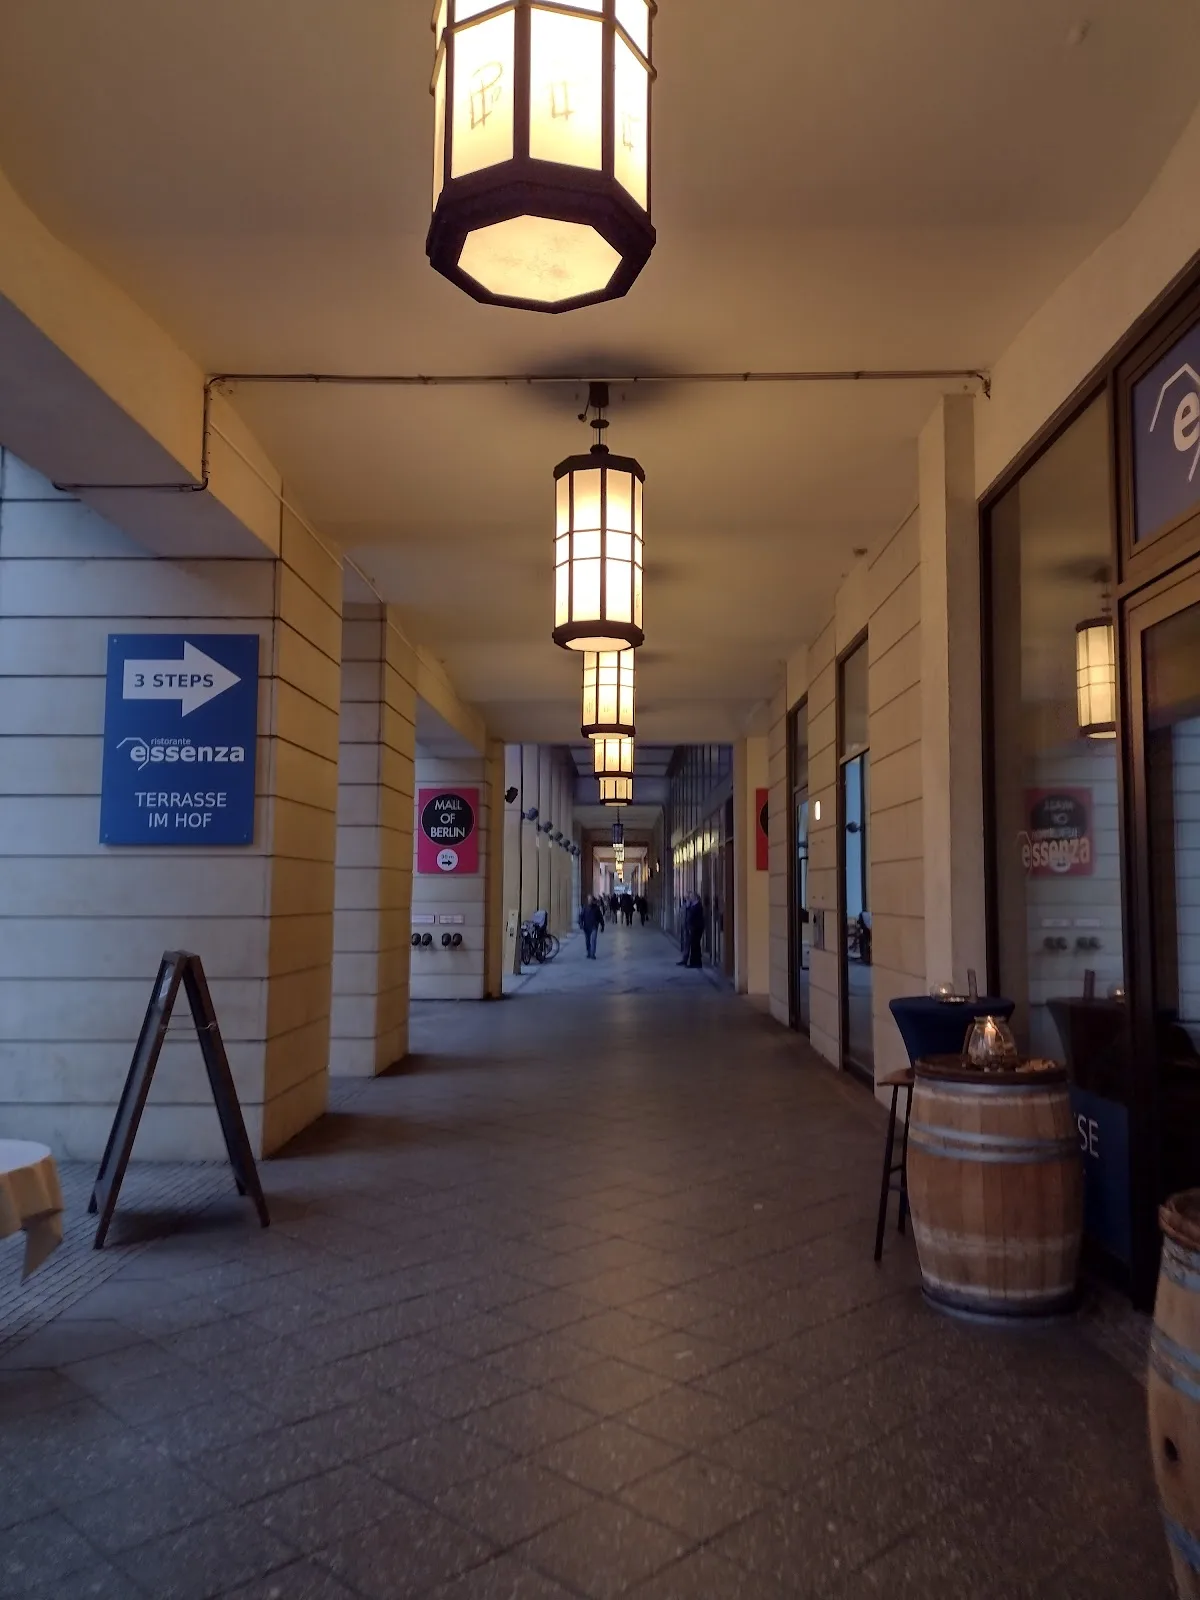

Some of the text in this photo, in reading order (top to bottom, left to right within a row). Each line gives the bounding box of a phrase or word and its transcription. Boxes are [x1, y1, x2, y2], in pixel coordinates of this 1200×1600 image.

[134, 674, 214, 688] 3 STEPS
[150, 737, 191, 745] ristorante
[130, 746, 245, 762] essenza
[134, 792, 227, 808] TERRASSE
[434, 800, 462, 811] MALL
[148, 813, 212, 828] IM HOF
[440, 813, 455, 824] OF
[430, 827, 465, 838] BERLIN
[1022, 836, 1090, 868] essenza
[1074, 1112, 1099, 1158] SE
